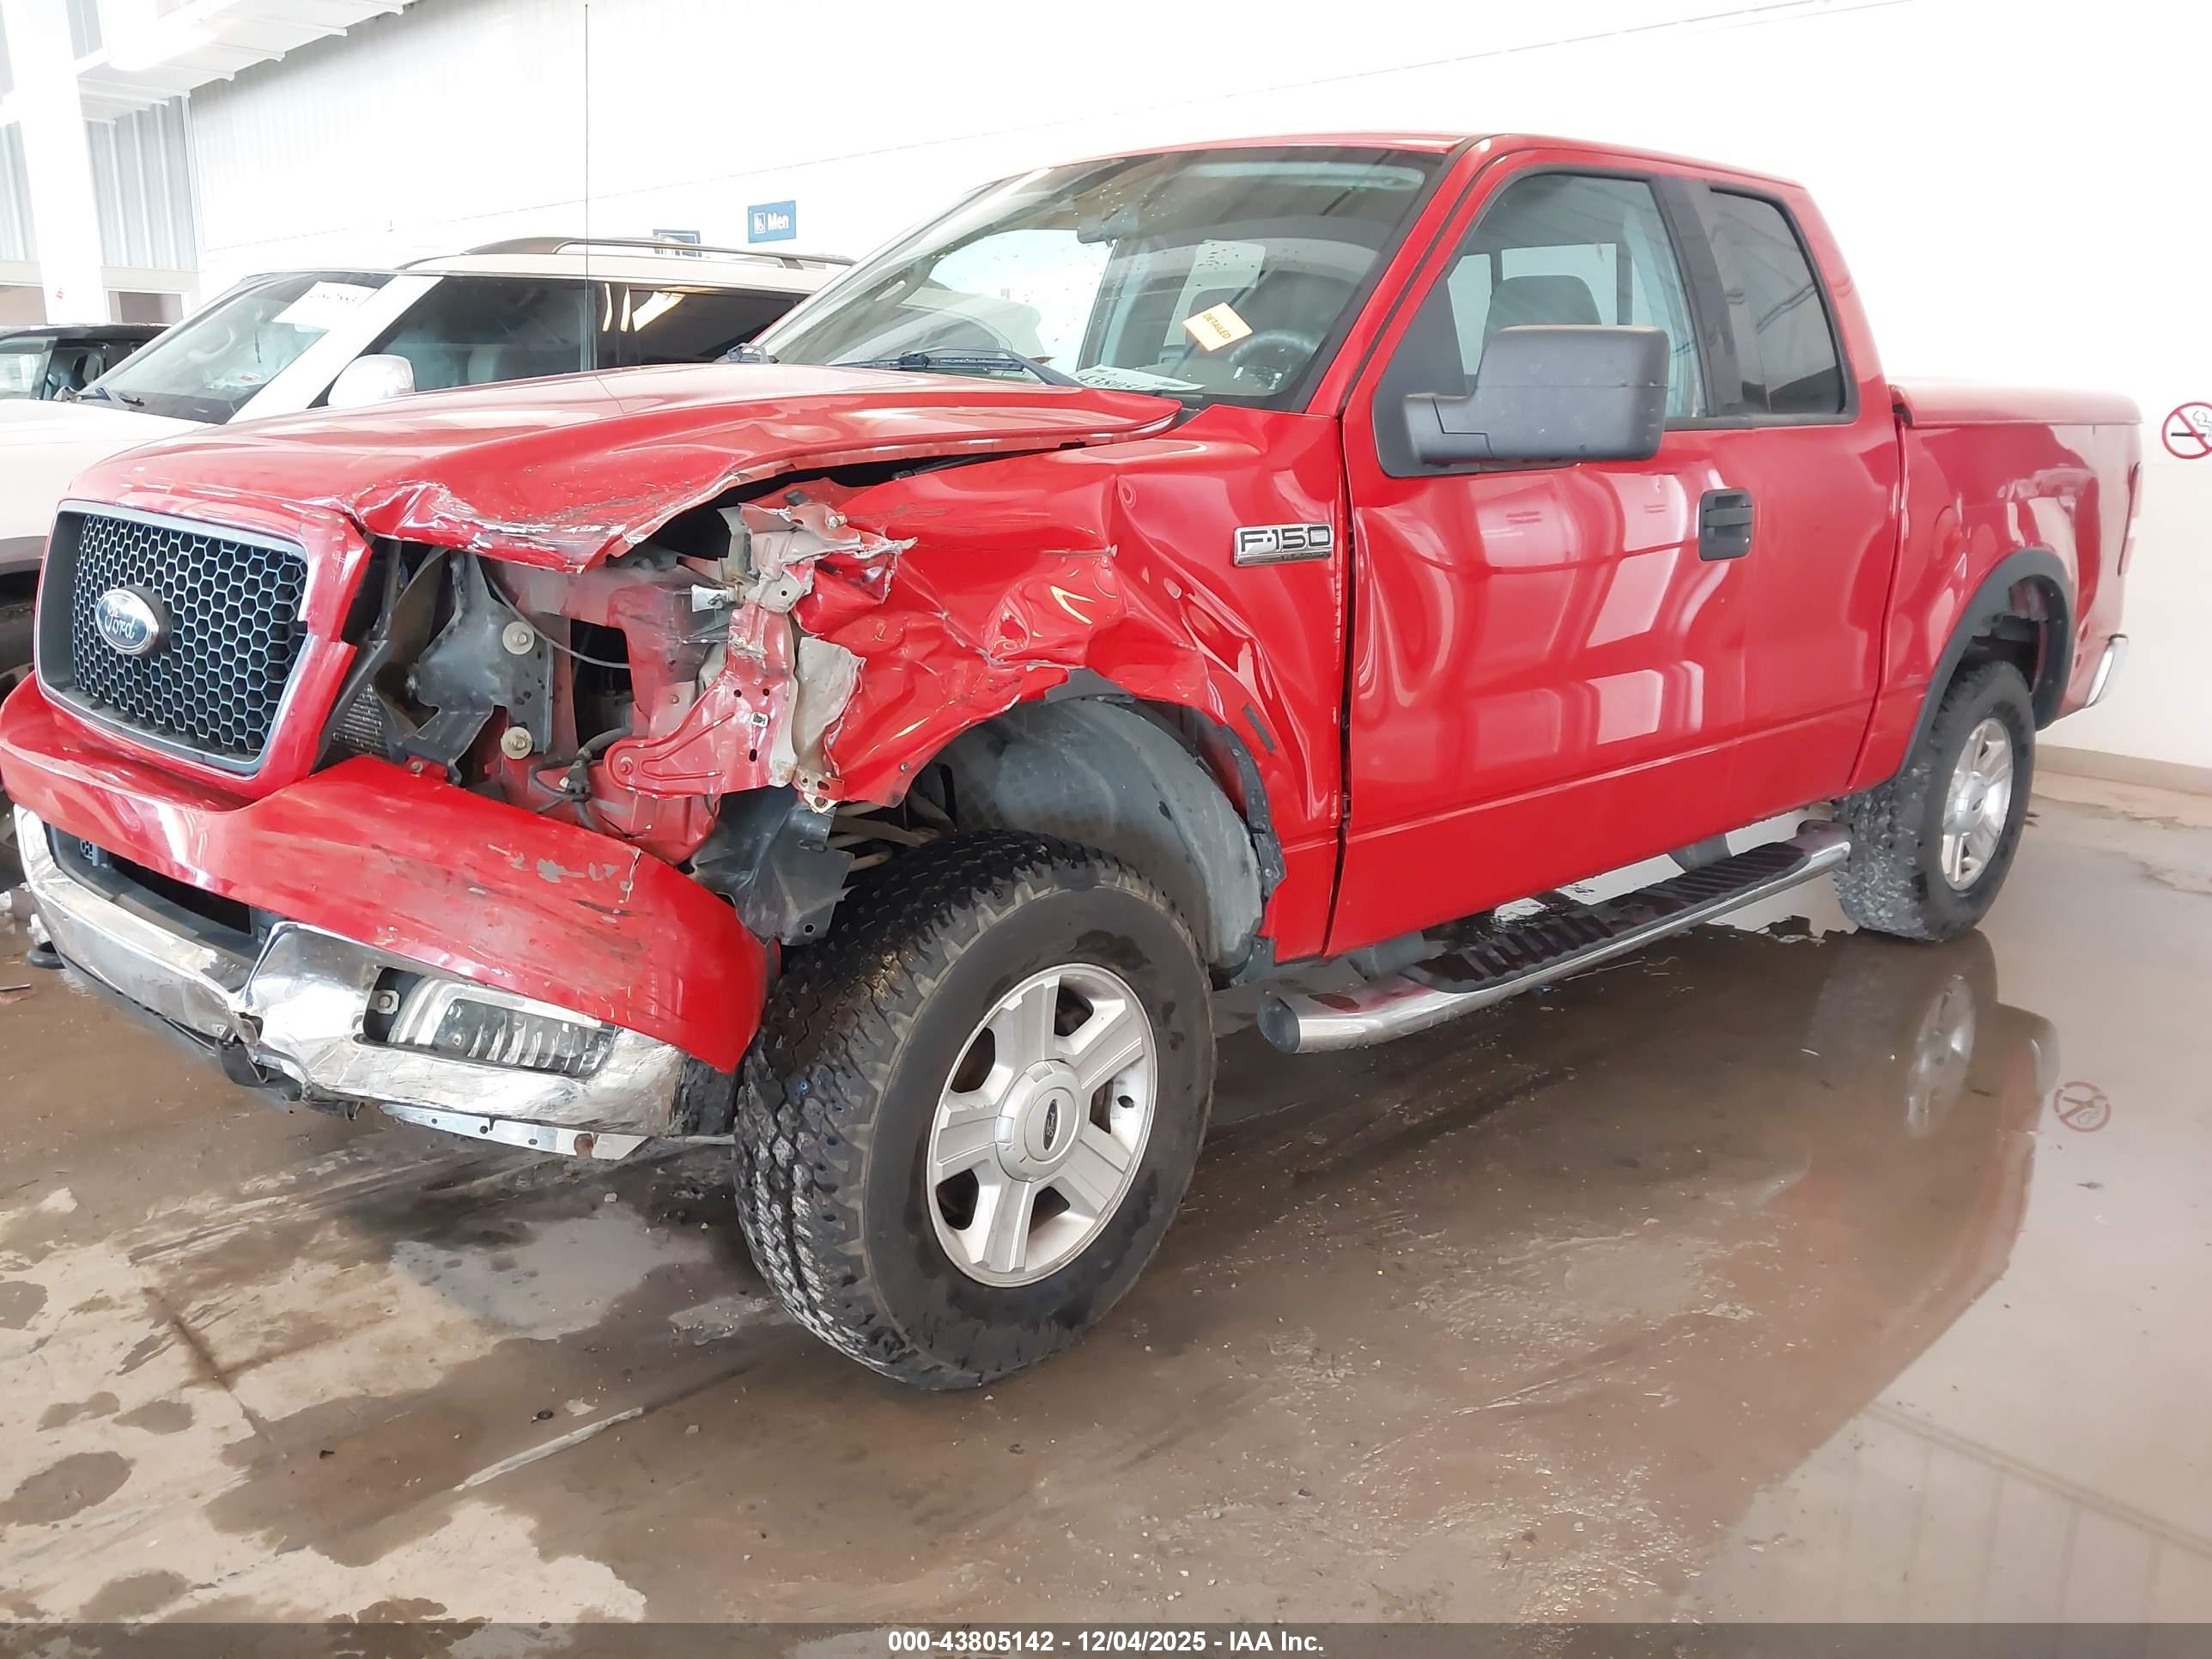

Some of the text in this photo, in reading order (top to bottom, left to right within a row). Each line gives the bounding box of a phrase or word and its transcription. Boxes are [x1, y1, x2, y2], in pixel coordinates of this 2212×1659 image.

[767, 212, 789, 230] Men
[1202, 313, 1231, 339] DETAILED
[105, 601, 136, 640] Ford
[1045, 1111, 1056, 1139] Ford
